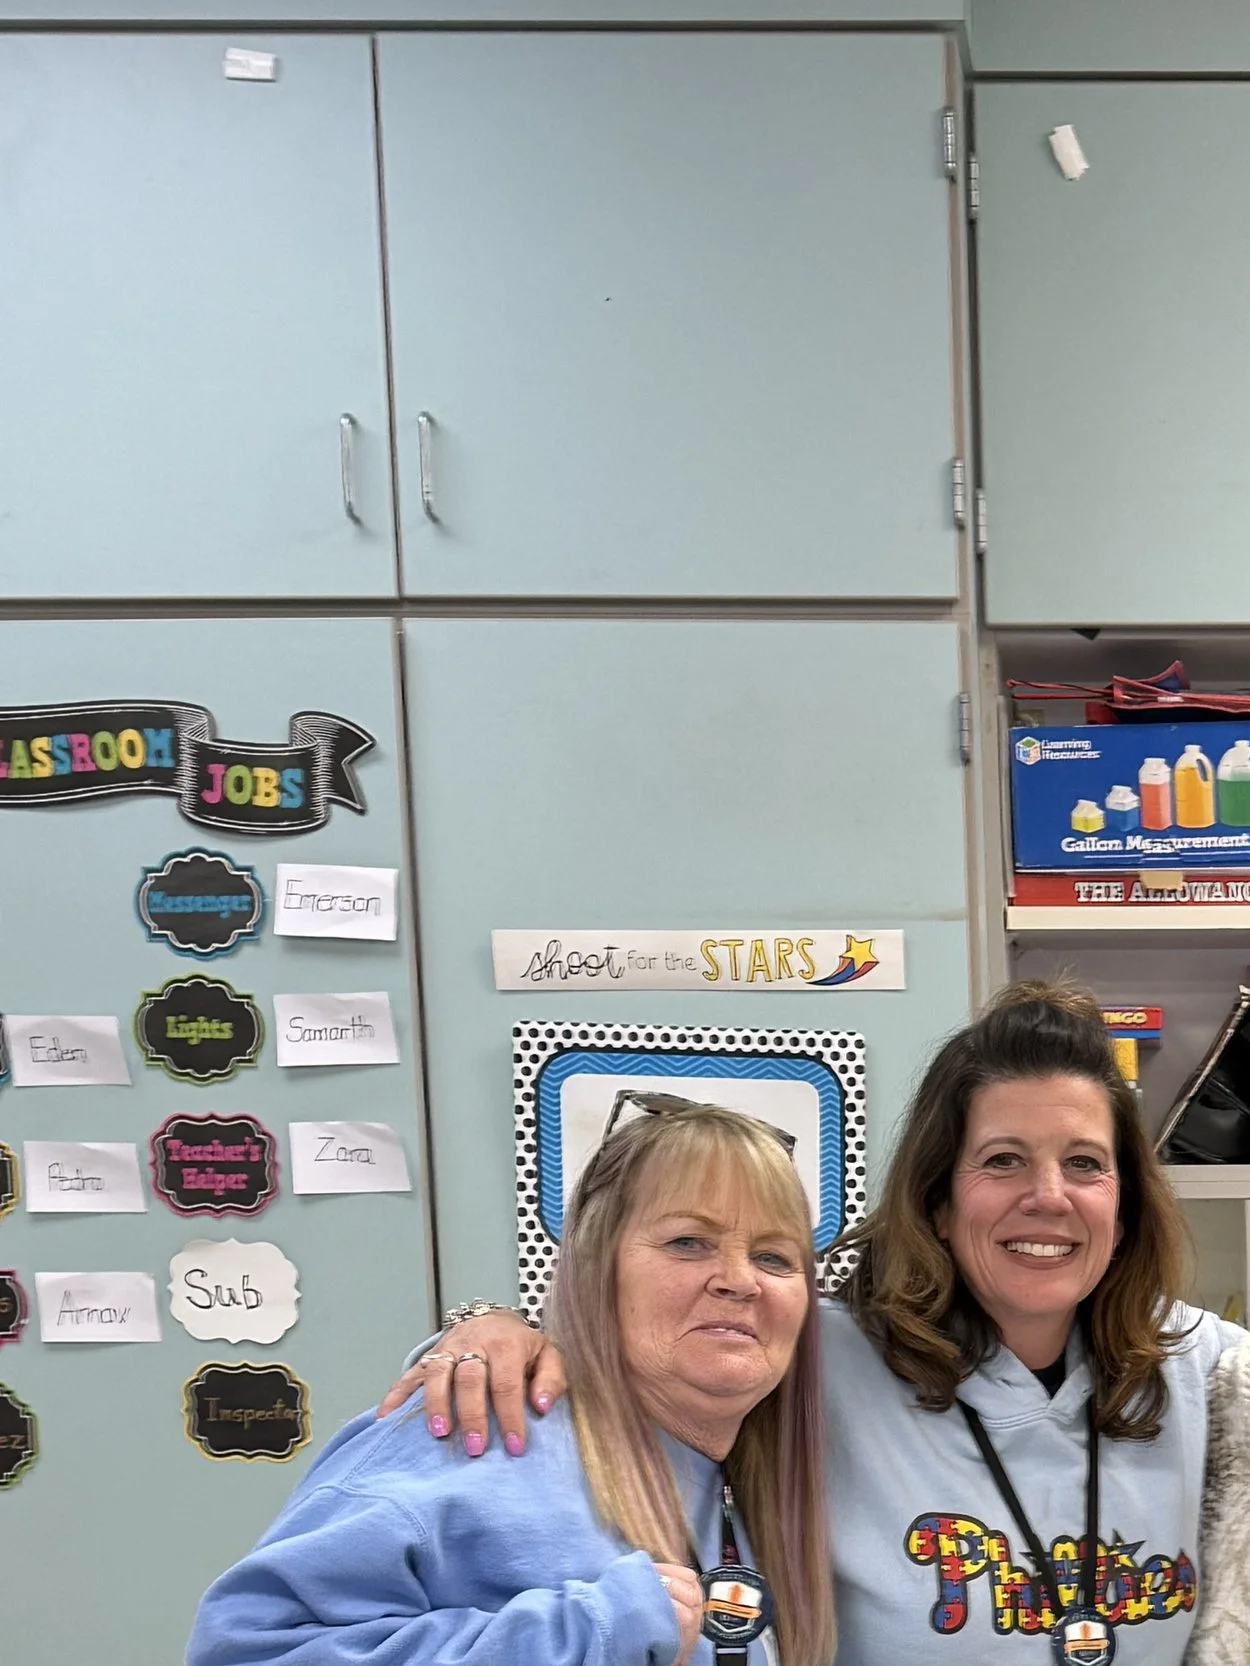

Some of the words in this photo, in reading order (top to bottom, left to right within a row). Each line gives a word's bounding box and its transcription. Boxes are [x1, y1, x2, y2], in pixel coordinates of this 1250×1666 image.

[203, 763, 304, 808] JOBS
[1060, 836, 1122, 853] Gallon
[1125, 833, 1250, 854] Measurement
[284, 878, 381, 916] Emerson
[1075, 881, 1124, 903] THE
[520, 939, 626, 982] shoot
[627, 950, 656, 970] for
[665, 949, 697, 972] the
[700, 938, 818, 983] STARS
[165, 1014, 234, 1046] Lights
[314, 1136, 376, 1165] Zara
[184, 1268, 263, 1310] Sub
